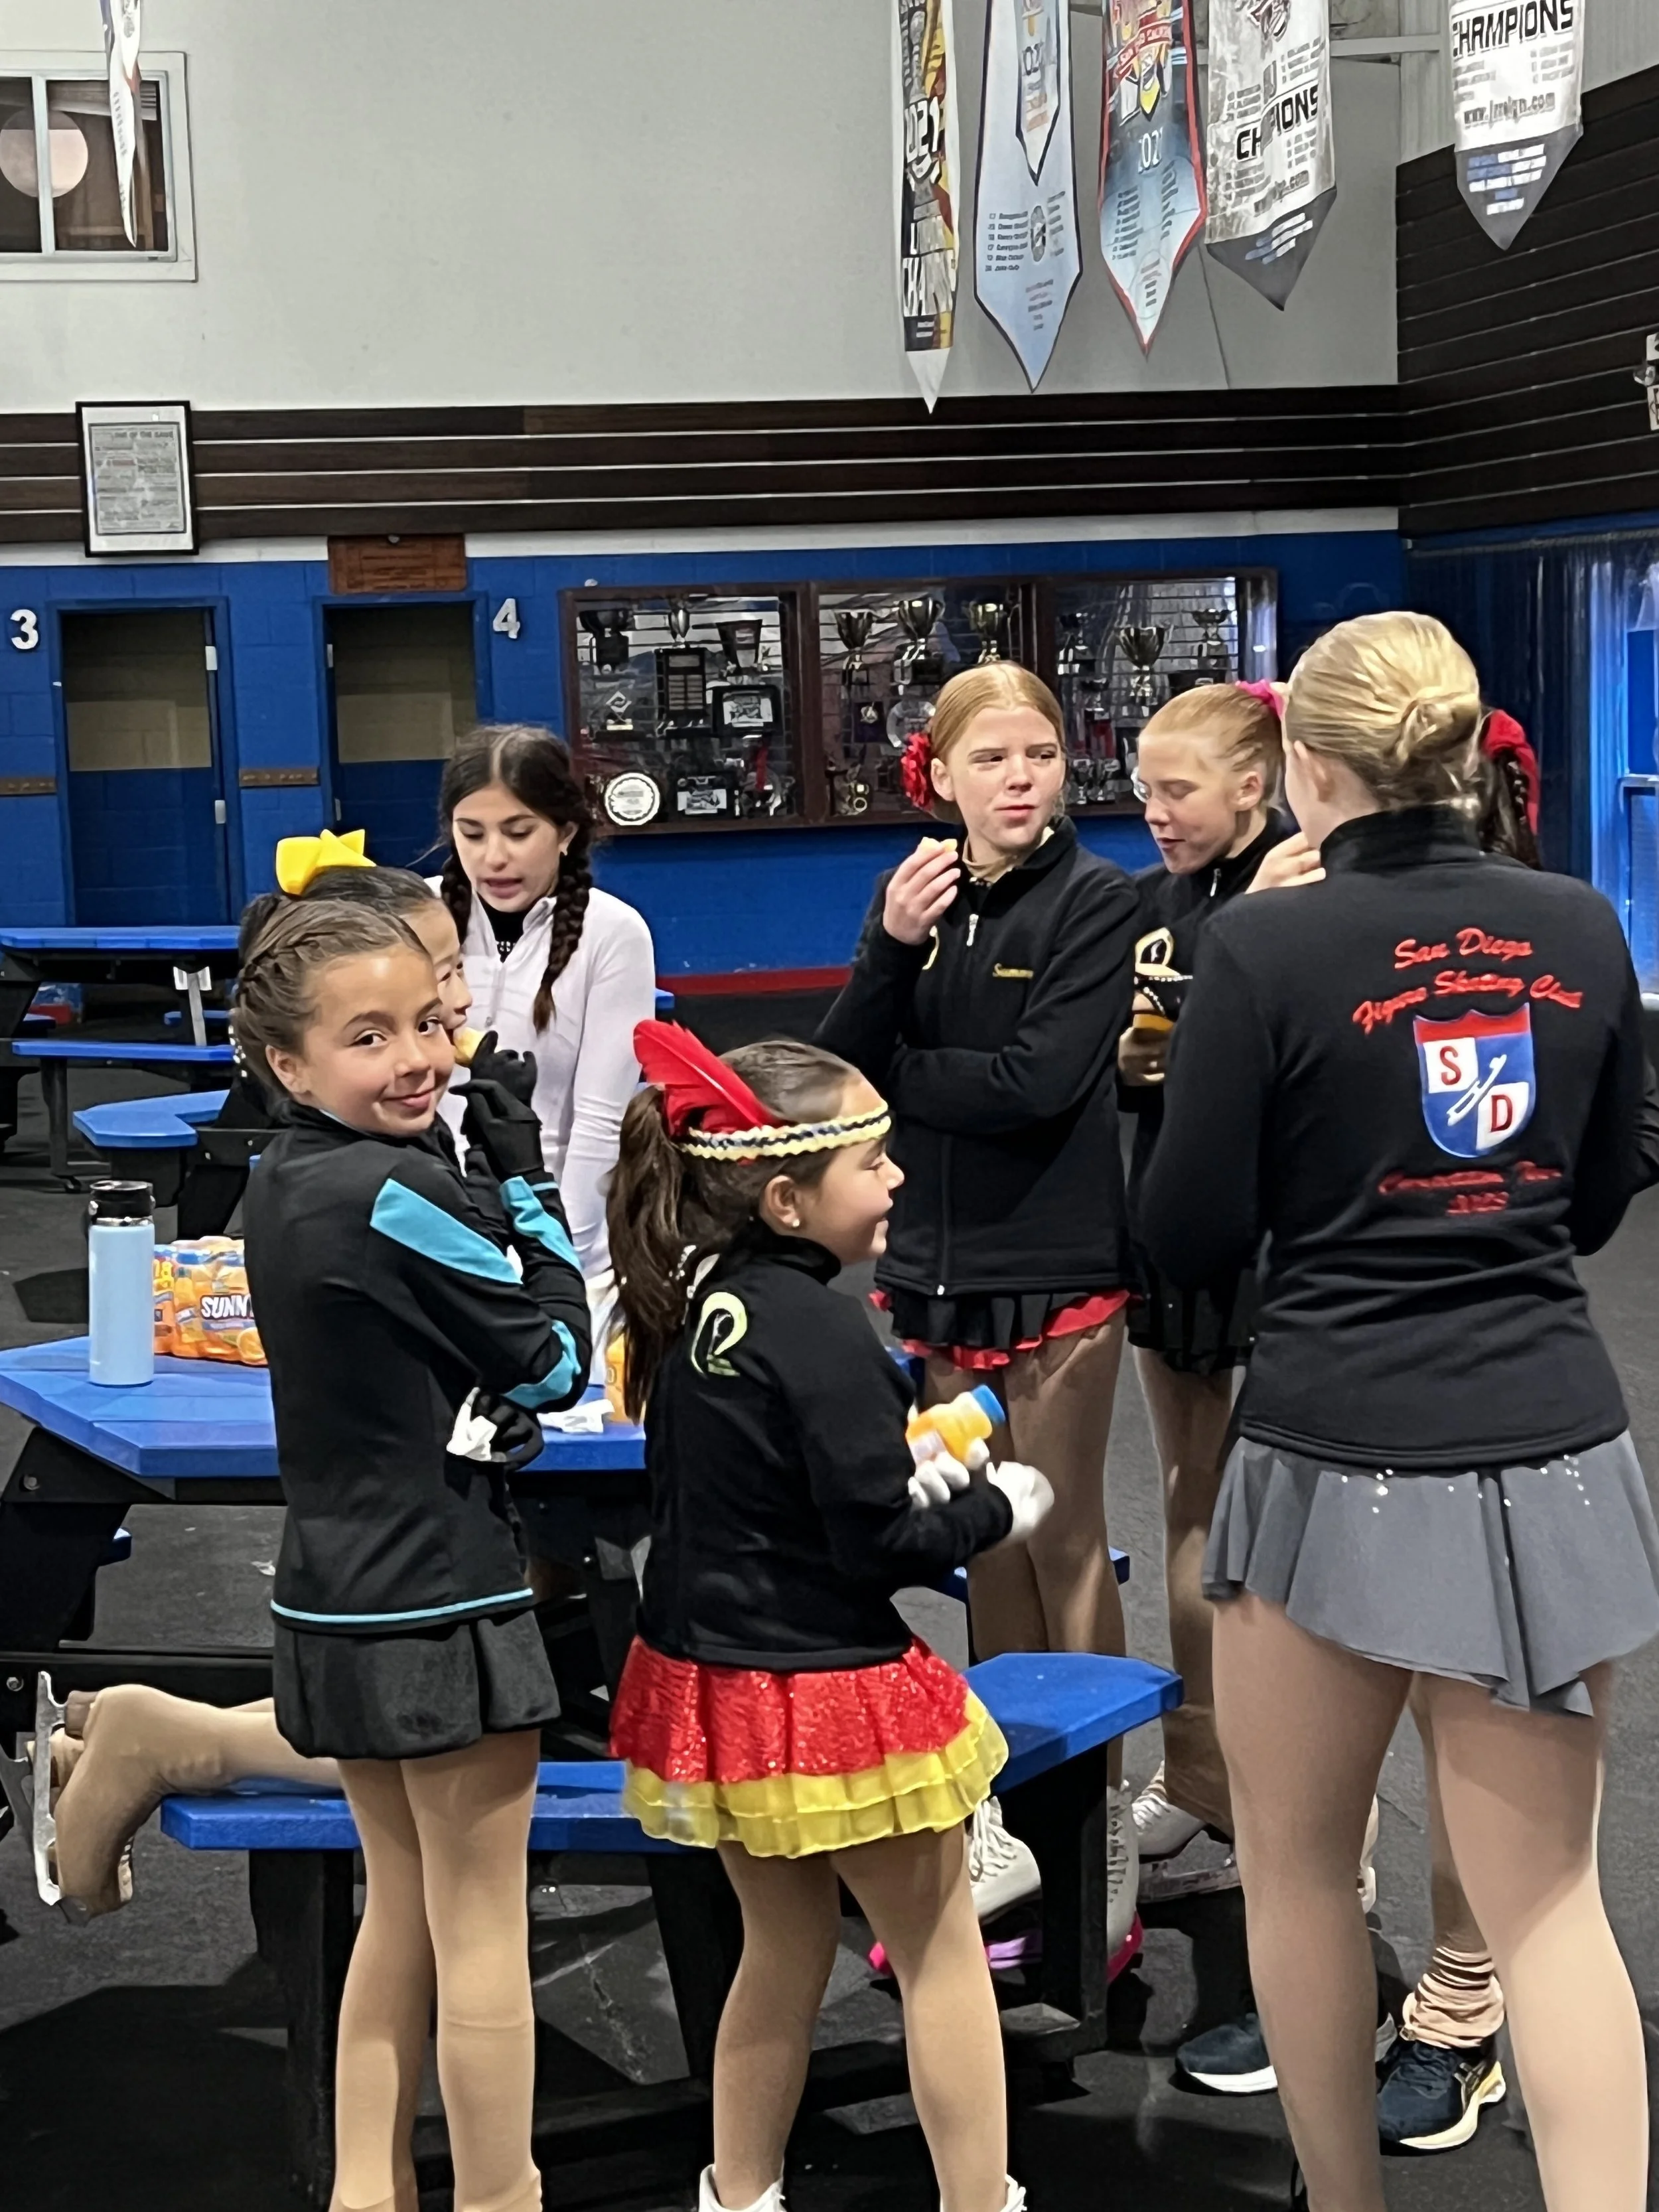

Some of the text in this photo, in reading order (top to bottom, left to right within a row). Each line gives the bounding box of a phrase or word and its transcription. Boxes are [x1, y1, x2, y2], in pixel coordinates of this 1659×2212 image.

[904, 96, 940, 164] 021
[1236, 84, 1319, 161] CHIONS
[10, 609, 38, 650] 3
[492, 597, 521, 639] 4
[1439, 1045, 1463, 1086] S
[1490, 1094, 1513, 1133] D
[200, 1294, 253, 1319] SUNN
